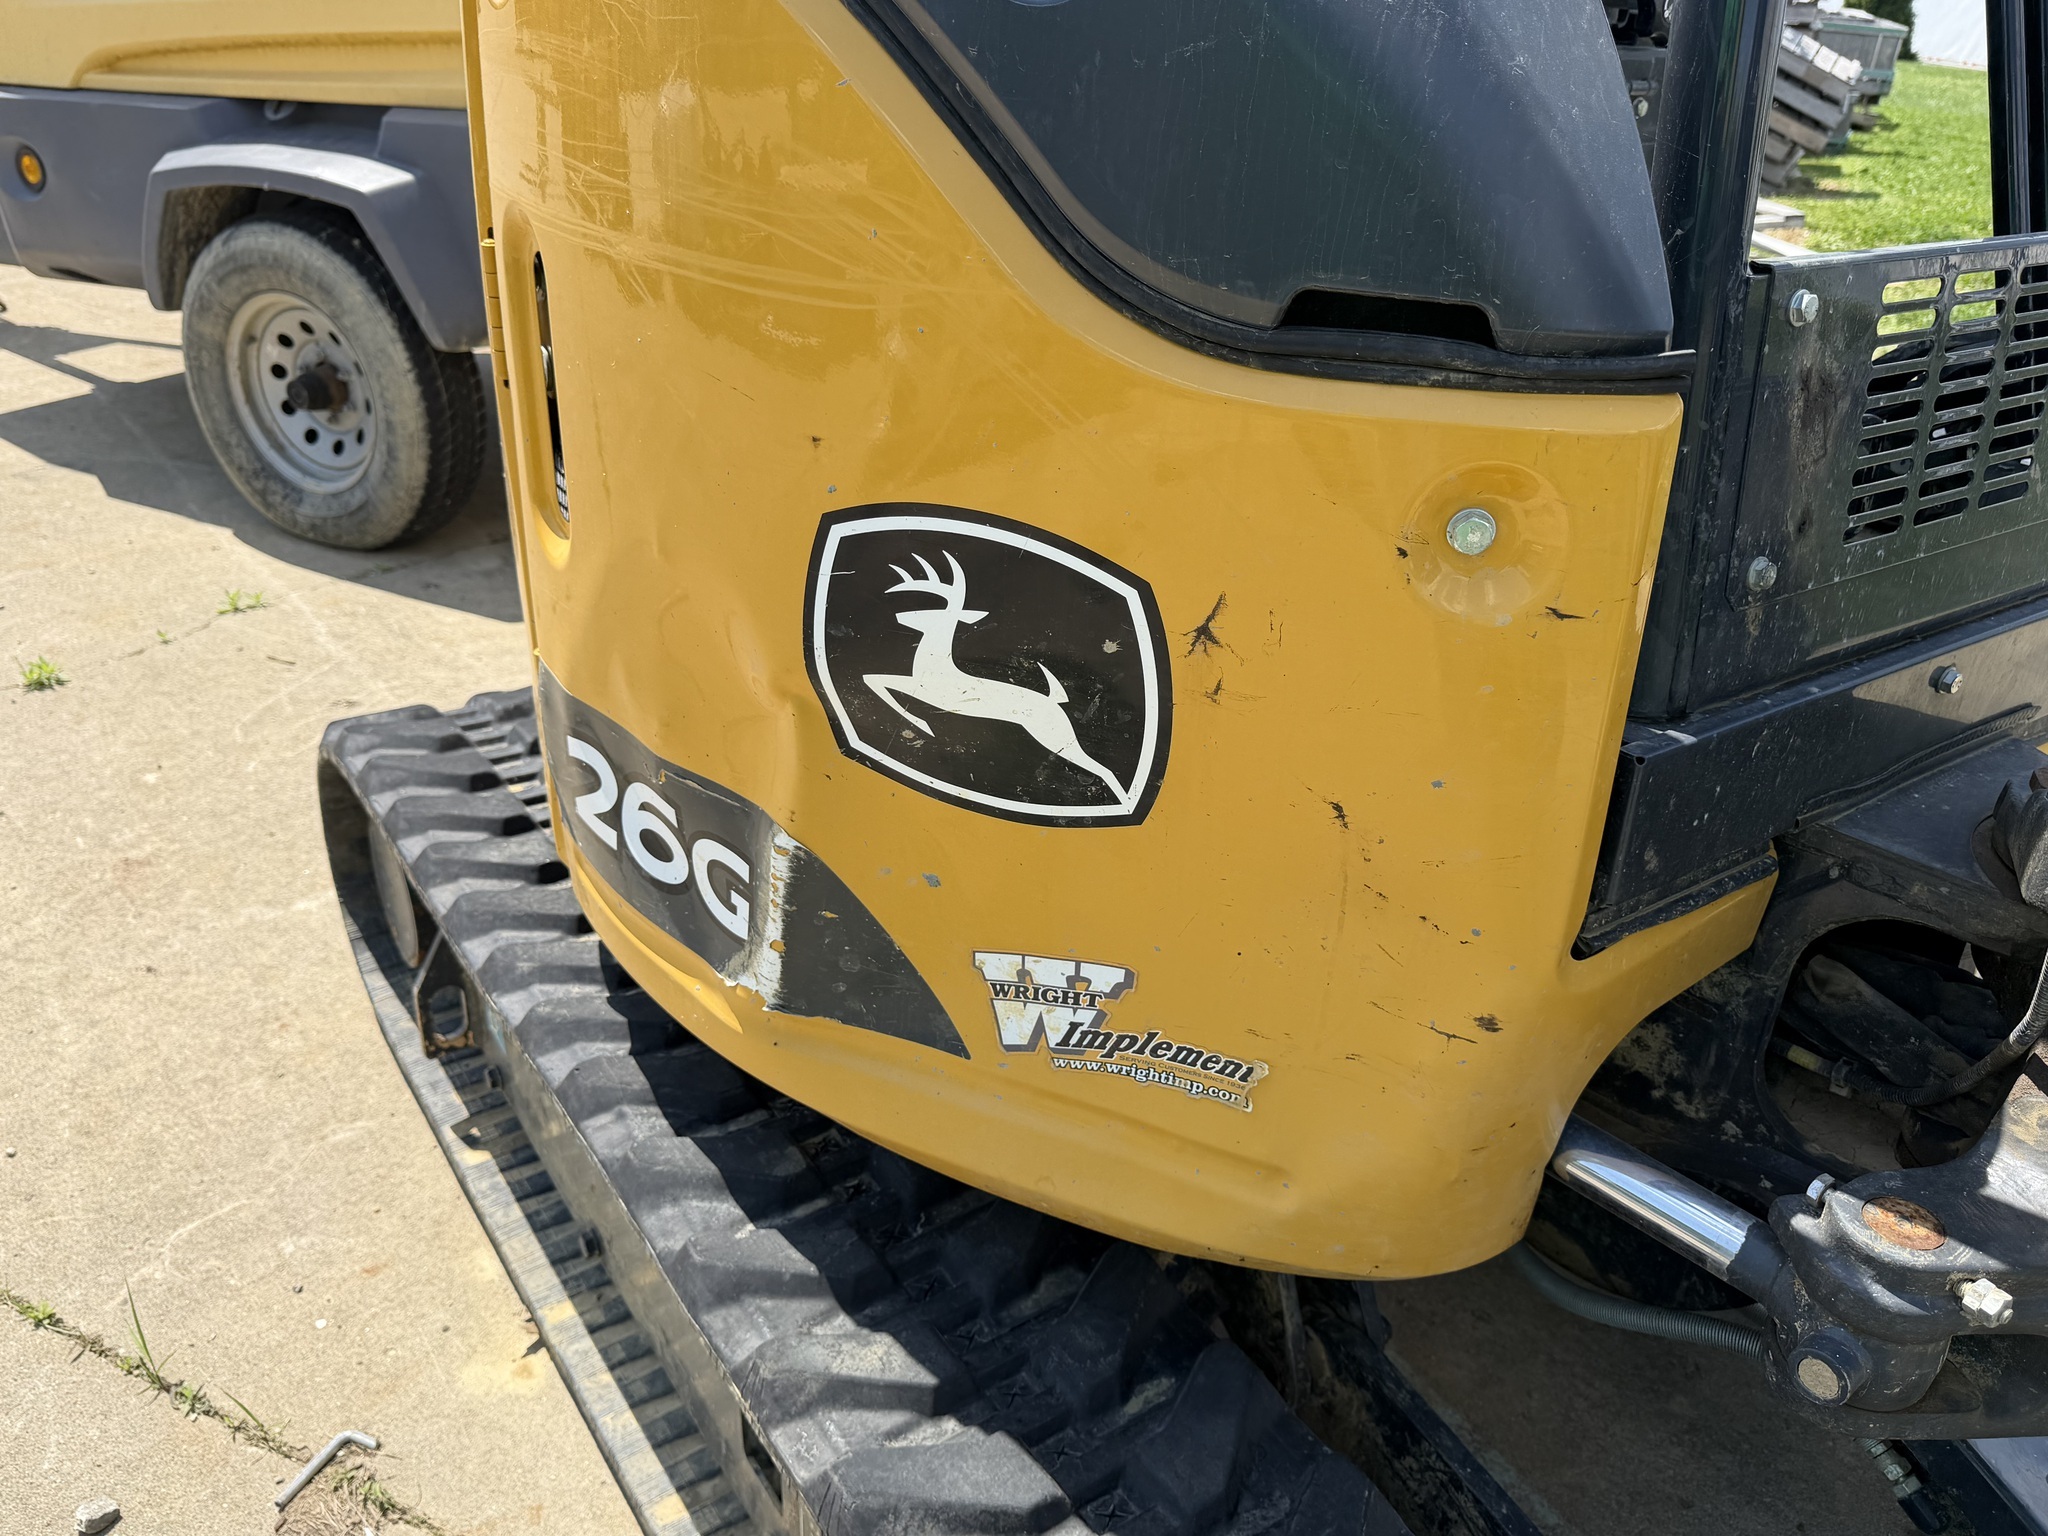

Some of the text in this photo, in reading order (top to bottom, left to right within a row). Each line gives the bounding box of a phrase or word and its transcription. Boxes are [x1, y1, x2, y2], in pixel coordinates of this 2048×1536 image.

[566, 734, 750, 941] 26G
[989, 982, 1103, 1008] WRIGHT
[1055, 1021, 1254, 1083] Implement
[1118, 1055, 1156, 1067] SERVING
[1158, 1060, 1202, 1078] CUSTOMERS
[1203, 1073, 1225, 1085] SINCE
[1053, 1058, 1249, 1108] www.wrightimp.com
